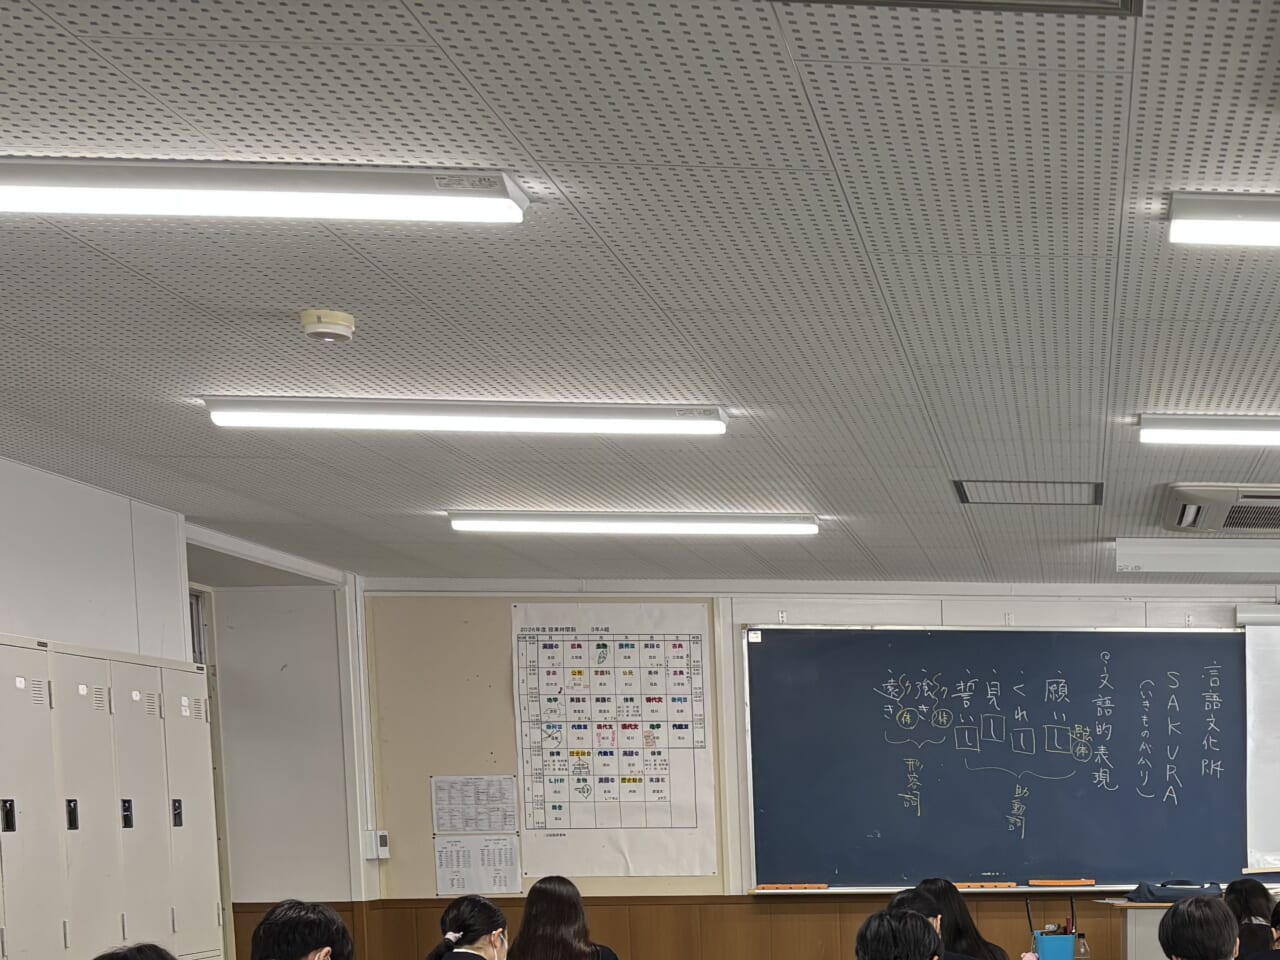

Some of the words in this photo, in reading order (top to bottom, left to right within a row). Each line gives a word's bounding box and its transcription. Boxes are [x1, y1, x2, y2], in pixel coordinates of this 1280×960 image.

[1162, 671, 1183, 806] SAKURA
[1201, 661, 1223, 751] 言語文化
